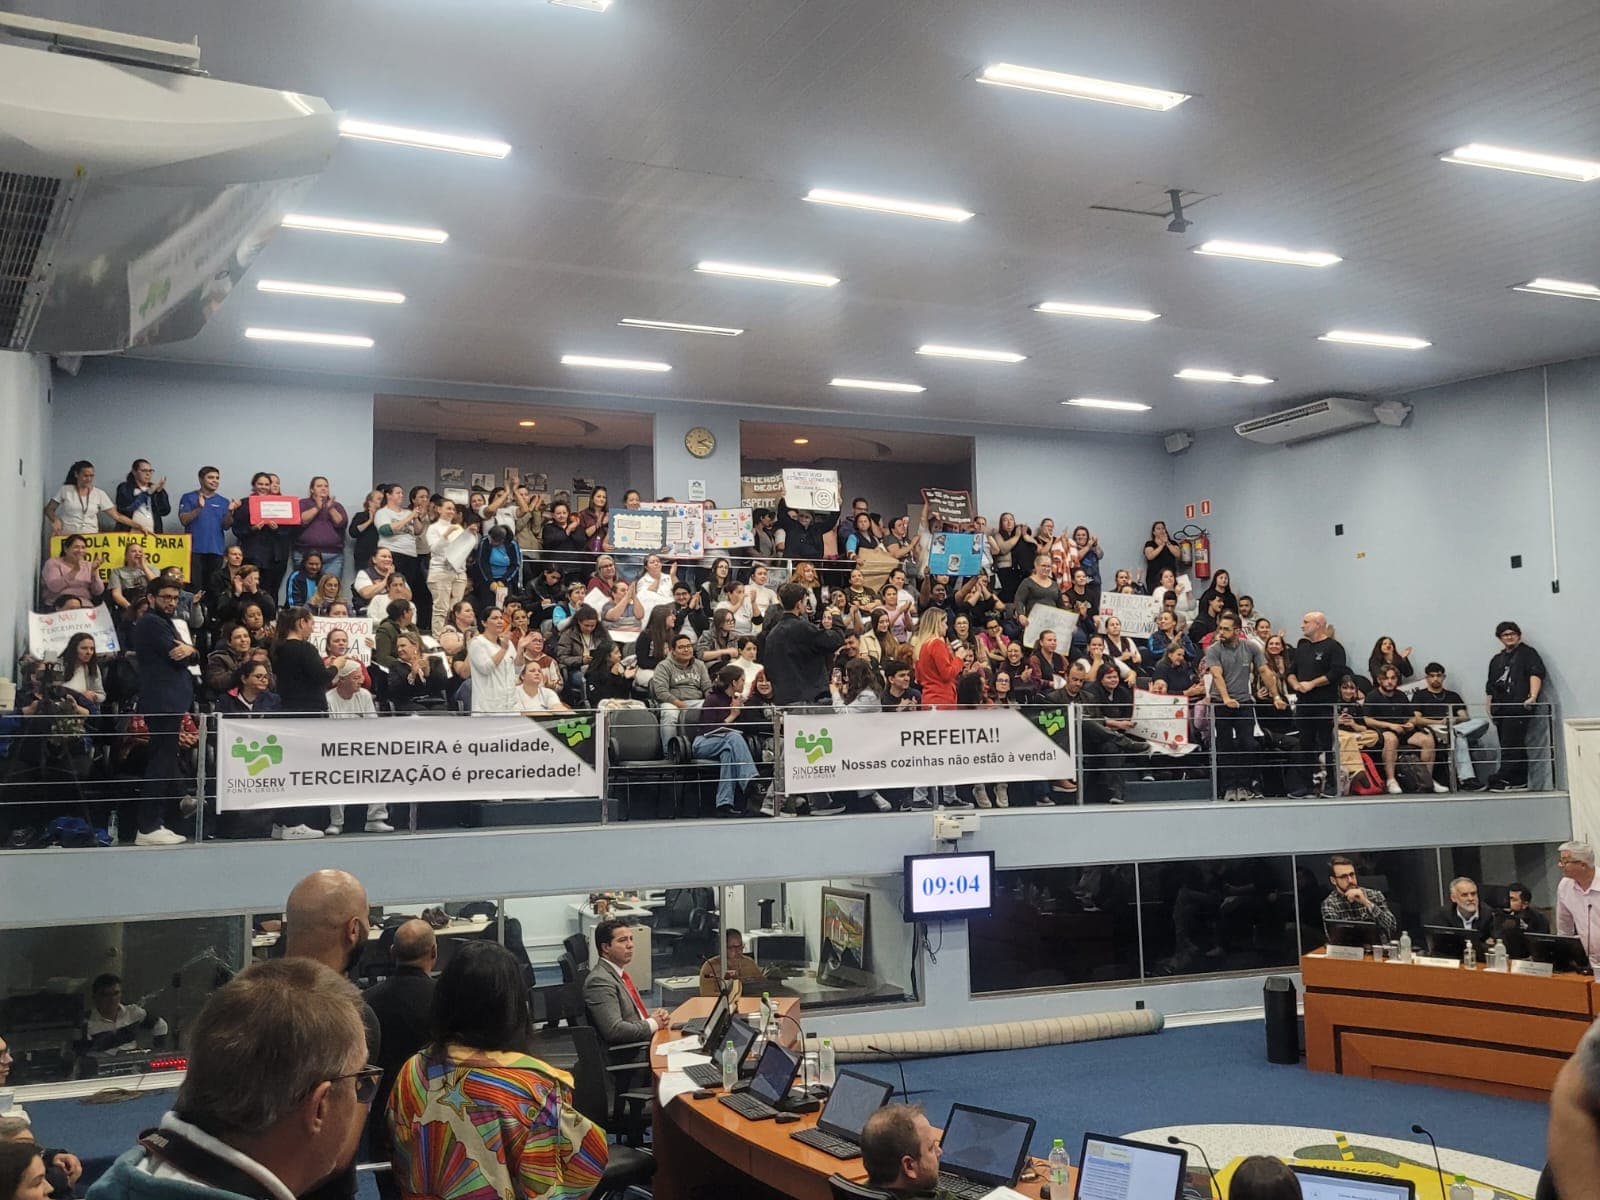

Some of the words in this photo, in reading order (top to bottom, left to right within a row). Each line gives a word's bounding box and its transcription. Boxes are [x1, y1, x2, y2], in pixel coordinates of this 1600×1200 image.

[155, 537, 184, 549] PARA
[900, 727, 1000, 747] PREFEITA!!
[321, 740, 448, 757] MERENDEIRA
[452, 740, 462, 754] é
[468, 738, 555, 756] qualidade,
[841, 759, 887, 771] Nossas
[890, 756, 944, 768] cozinhas
[948, 754, 970, 766] não
[973, 752, 1005, 764] estão
[1008, 752, 1015, 763] à
[1018, 750, 1057, 762] venda!
[289, 765, 447, 786] TERCEIRIZAÇÃO
[452, 767, 461, 781] é
[467, 763, 581, 783] precariedade!
[792, 765, 837, 776] SINDSERV
[227, 778, 286, 789] SINDSERV
[922, 874, 980, 897] 09:04
